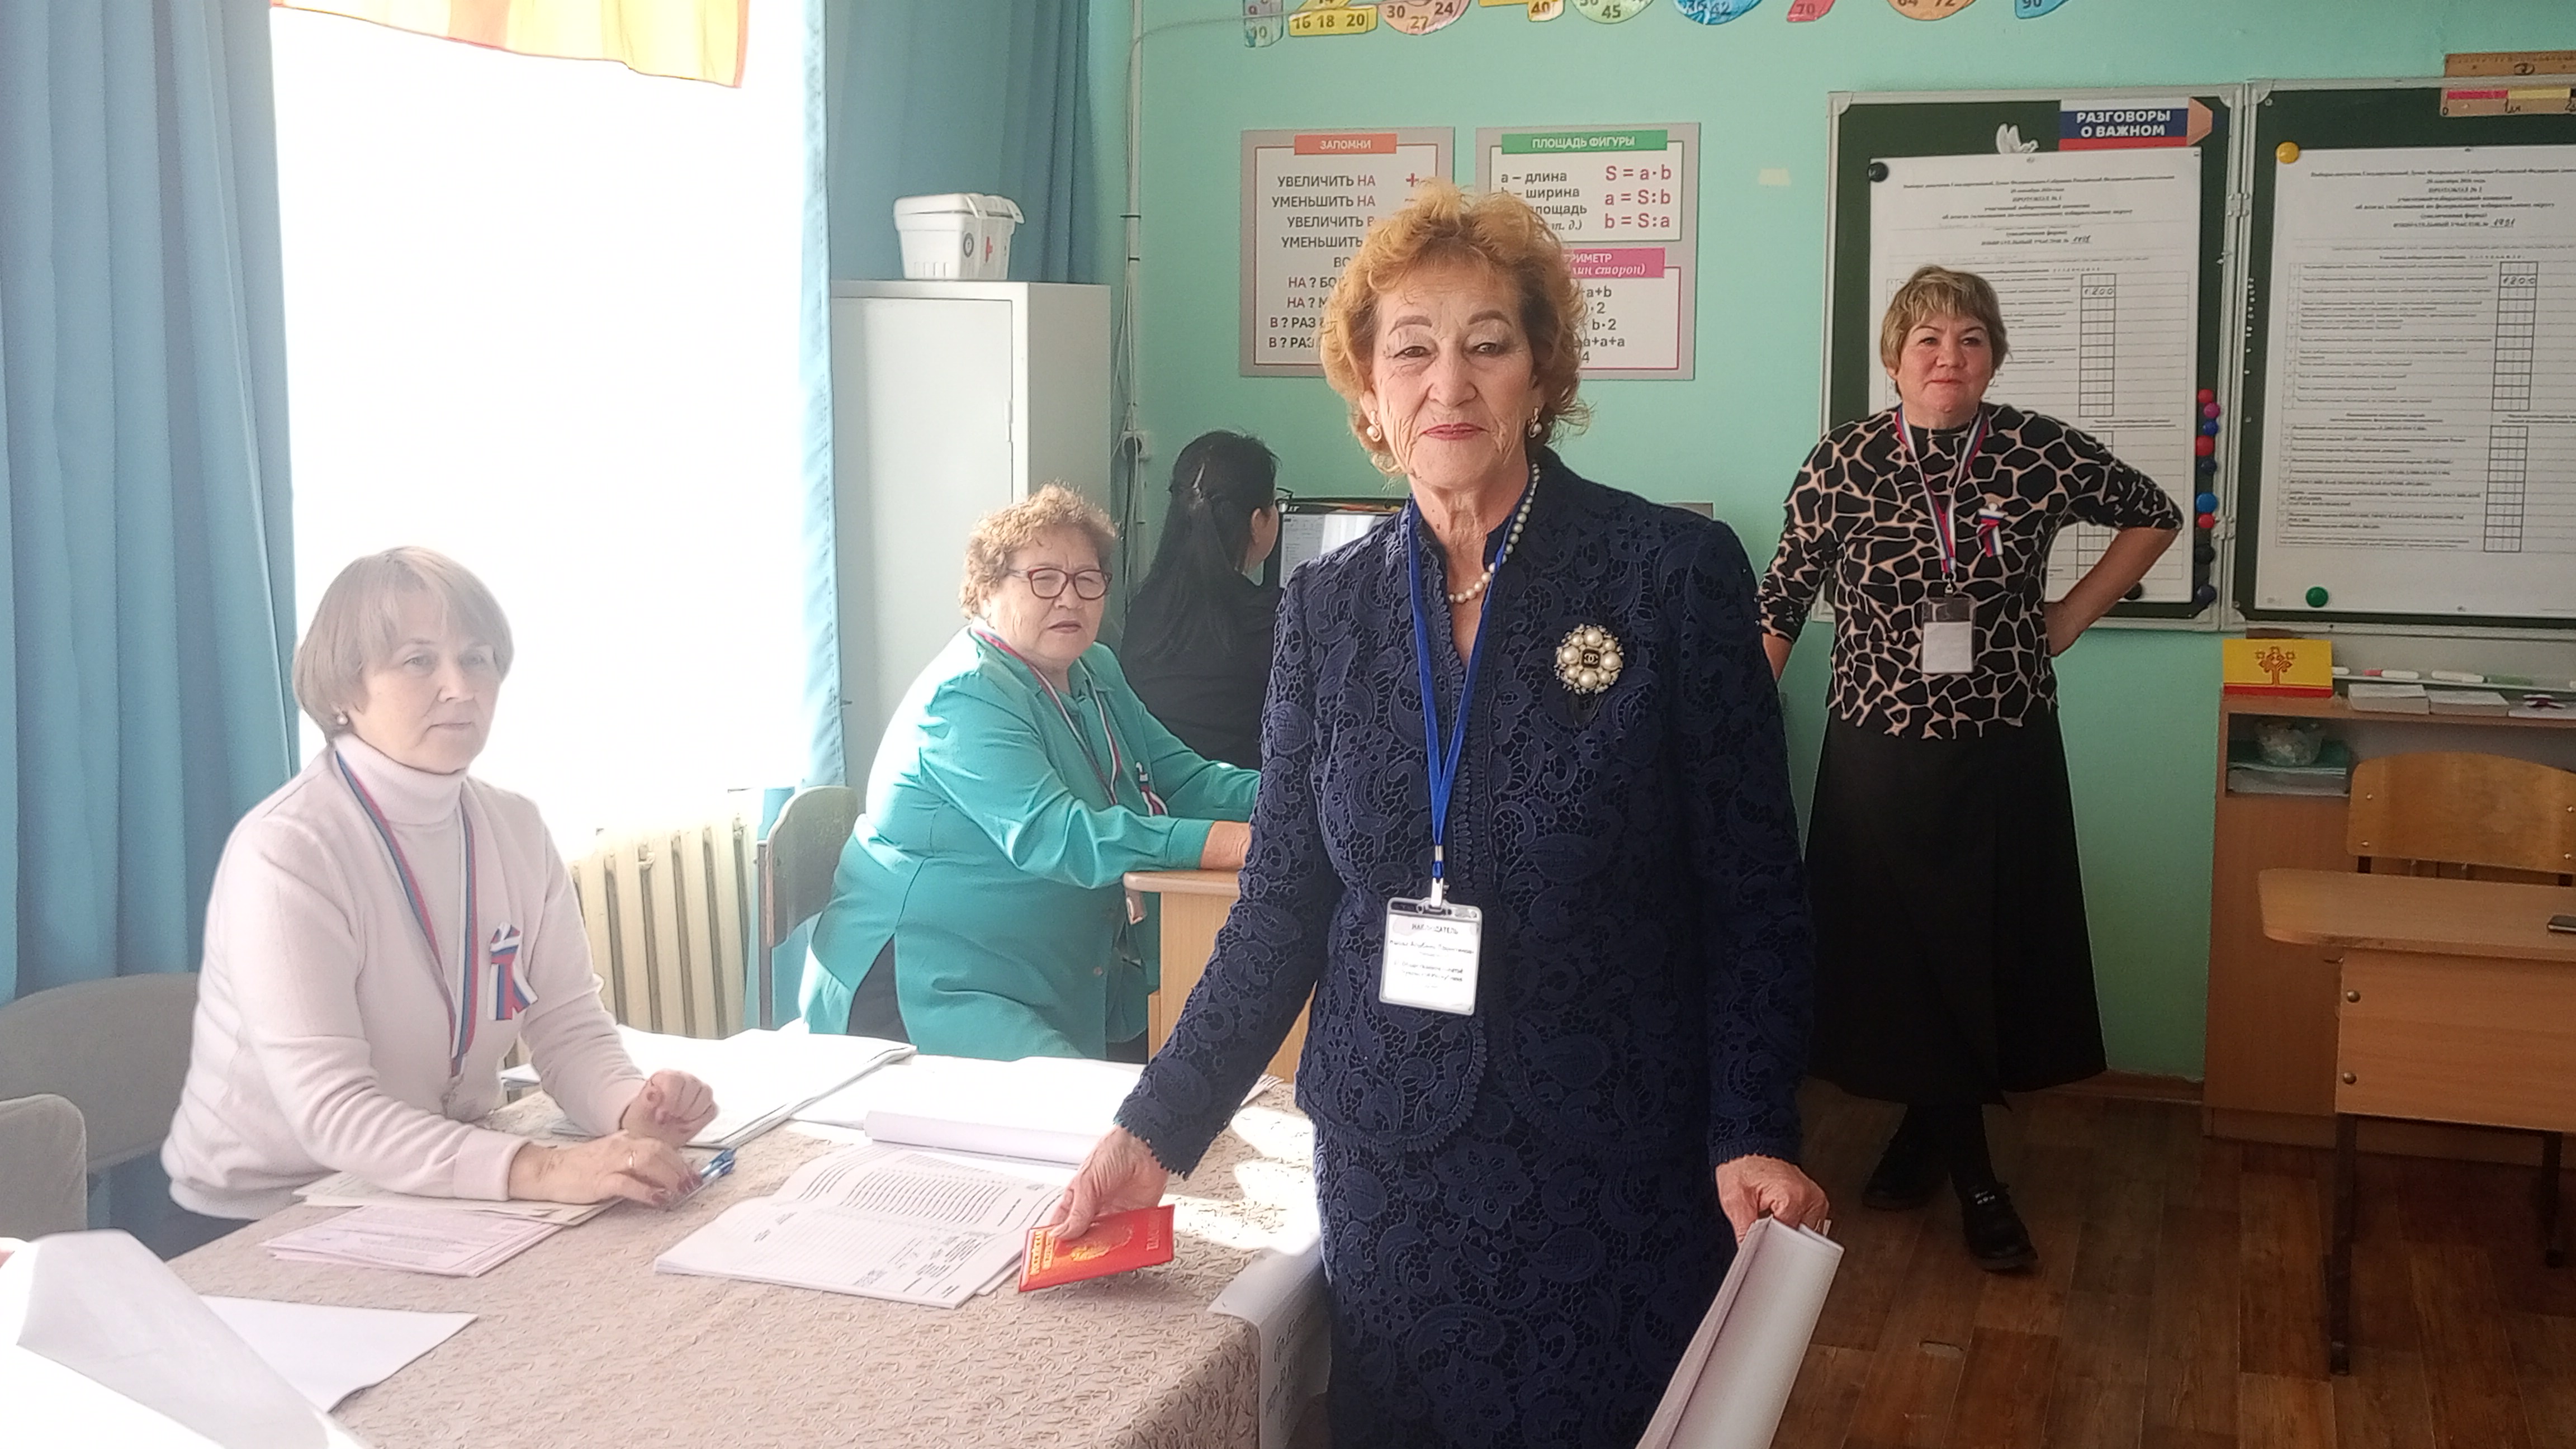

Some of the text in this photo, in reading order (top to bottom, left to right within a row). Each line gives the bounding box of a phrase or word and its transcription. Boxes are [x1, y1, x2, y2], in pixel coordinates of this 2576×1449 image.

[1386, 5, 1406, 18] 30
[1433, 2, 1454, 15] 24
[1601, 5, 1621, 19] 45
[1796, 3, 1815, 15] 70
[1291, 13, 1365, 29] 16 18 20
[1409, 16, 1429, 30] 27
[2076, 111, 2171, 124] РАЗГОВОРЫ
[2081, 125, 2166, 138] О ВАЖНОМ
[1319, 139, 1372, 150] ЗАПОМНИ
[1532, 136, 1635, 150] ПЛОЩАДЬ ФИГУРЫ
[1525, 171, 1567, 183] длина
[1606, 165, 1617, 181] S
[1277, 176, 1354, 188] УВЕЛИЧИТЬ
[1357, 175, 1376, 187] НА
[1526, 187, 1580, 201] ширина
[1604, 195, 1614, 205] a
[1271, 196, 1376, 207] УМЕНЬШИТЬ НА
[1534, 205, 1587, 216] лощадь
[1287, 216, 1363, 228] УВЕЛИЧИТЬ
[1604, 213, 1614, 229] b
[1281, 237, 1363, 248] УМЕНЬШИТЬ
[1595, 263, 1646, 278] сторон)
[1288, 277, 1306, 288] НА
[1309, 277, 1317, 288] ?
[1287, 297, 1305, 309] НА
[1308, 297, 1315, 309] ?
[1270, 317, 1278, 328] В
[1281, 316, 1288, 328] ?
[1291, 316, 1316, 329] РАЗ
[1268, 337, 1314, 349] В ? РАЗ
